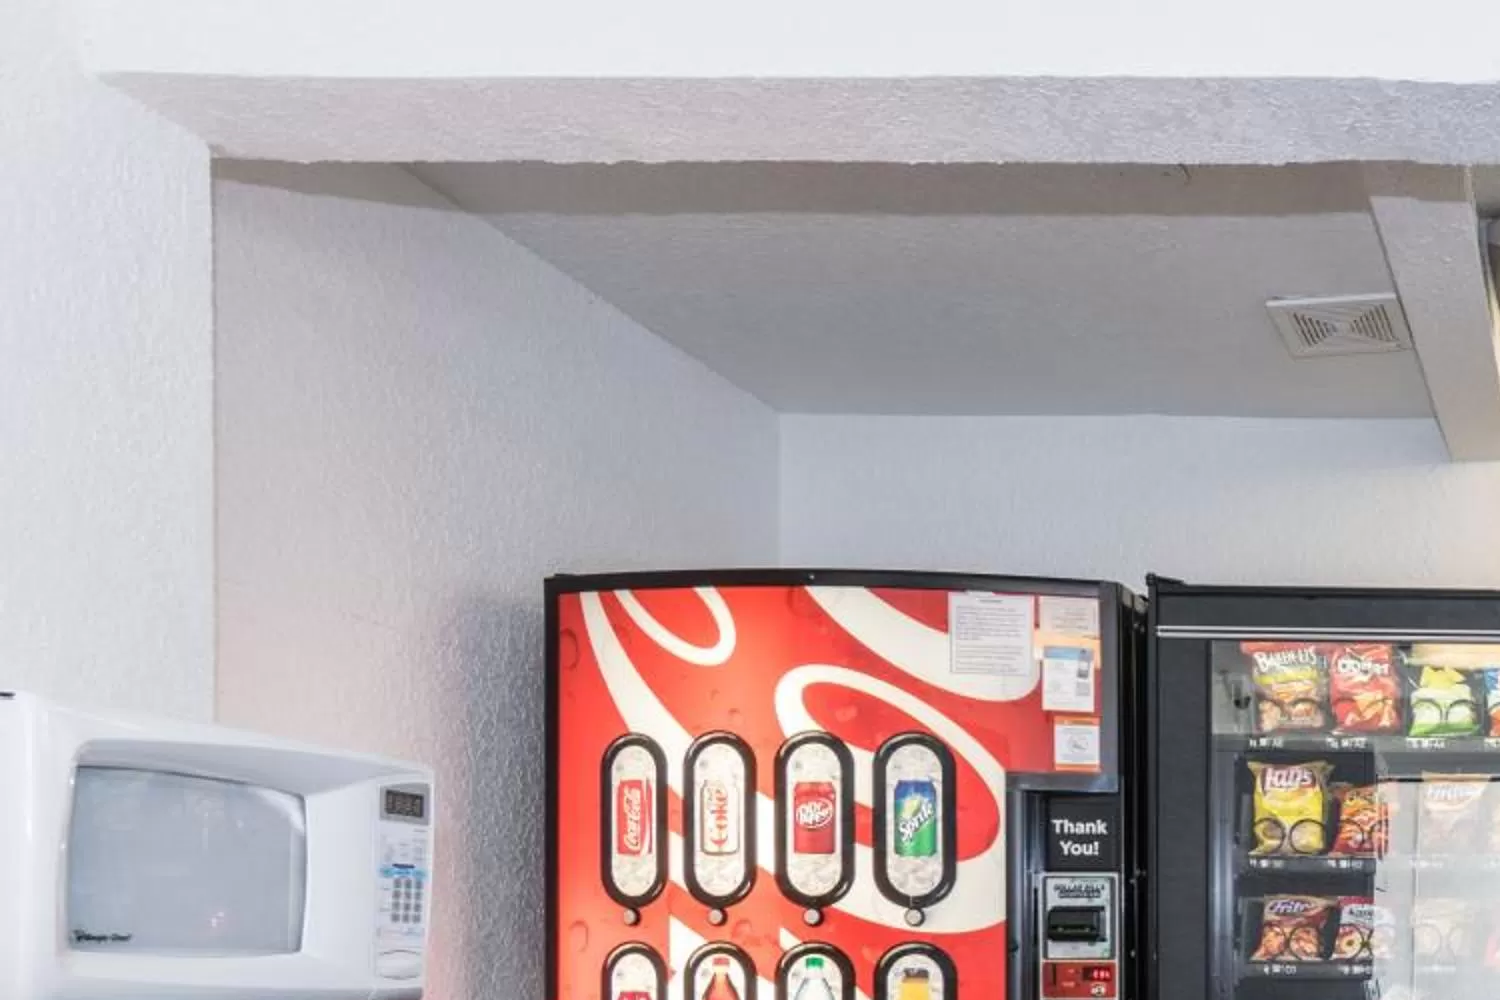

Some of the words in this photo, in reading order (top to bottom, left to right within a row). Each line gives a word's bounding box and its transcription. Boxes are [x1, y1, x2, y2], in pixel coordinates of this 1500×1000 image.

[899, 801, 933, 843] Sprite
[1052, 819, 1108, 835] Thank
[1060, 841, 1099, 856] You!
